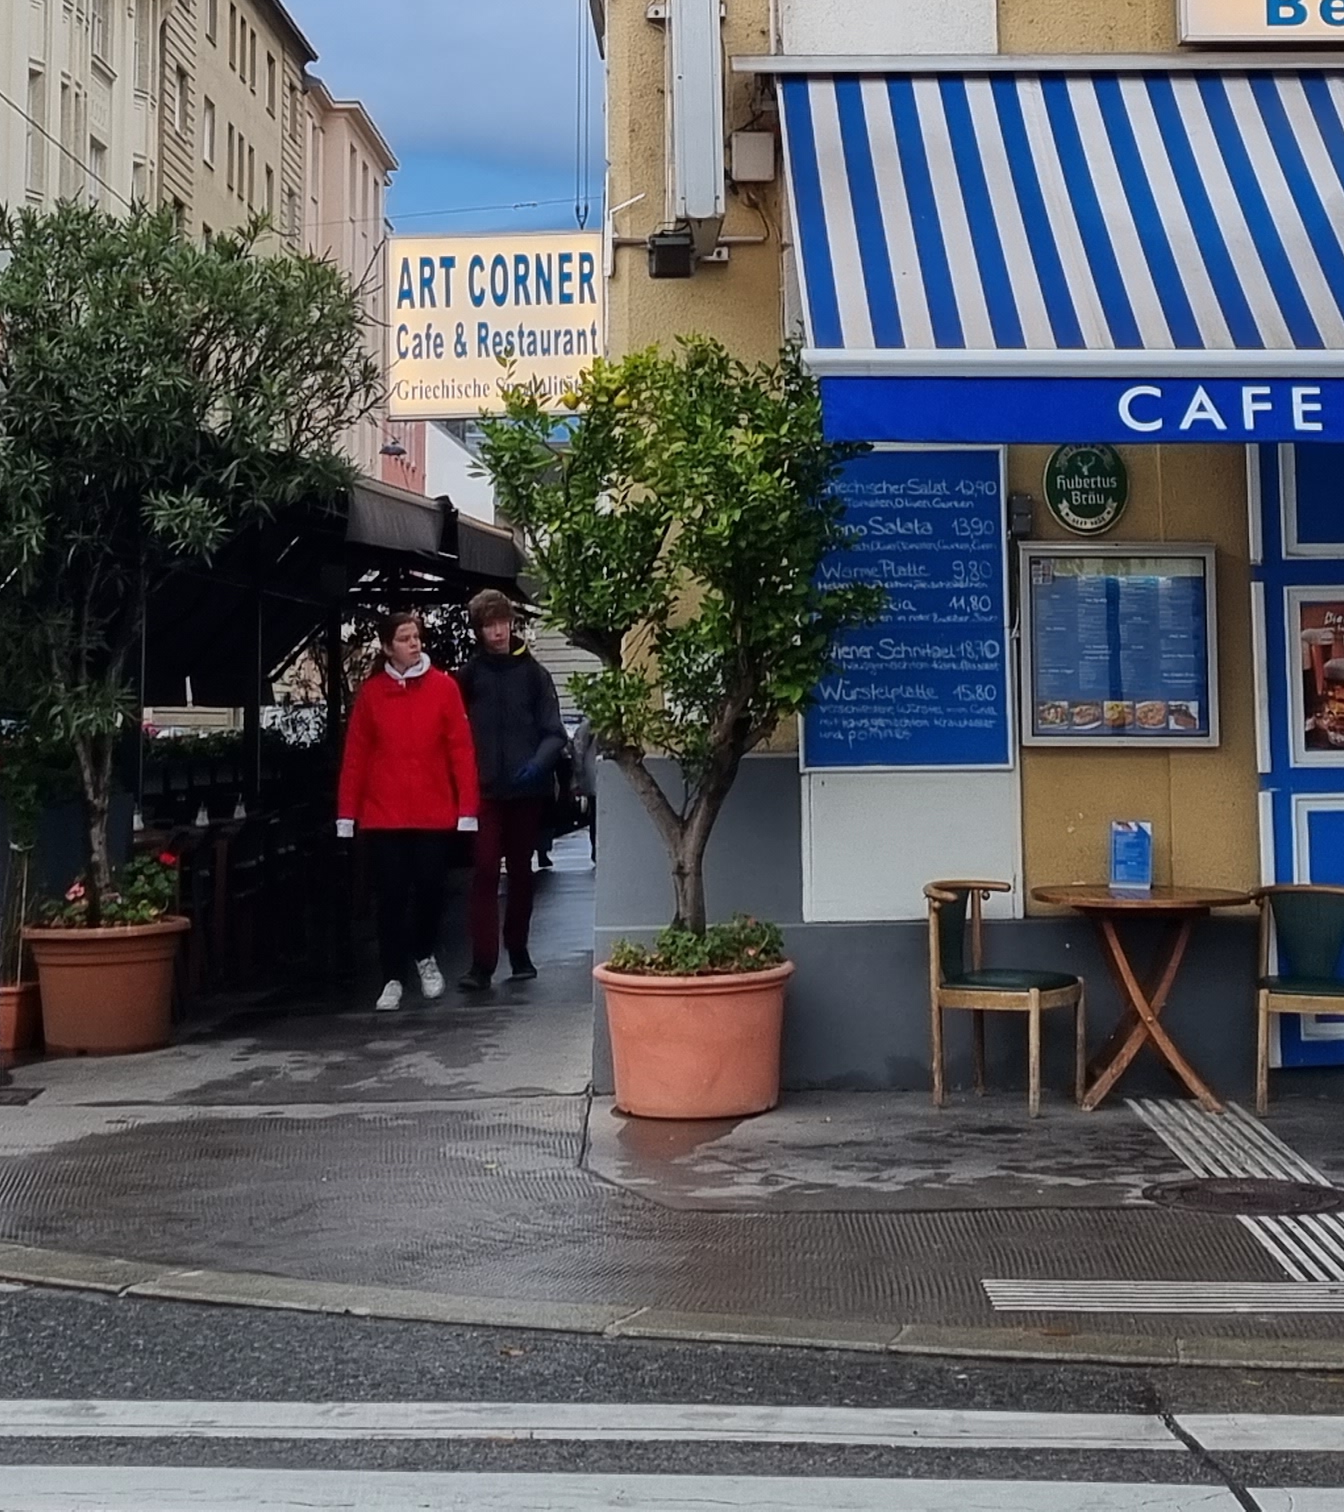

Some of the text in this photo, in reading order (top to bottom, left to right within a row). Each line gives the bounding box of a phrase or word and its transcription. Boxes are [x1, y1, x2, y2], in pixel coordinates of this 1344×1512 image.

[397, 252, 597, 310] ART CORNER
[396, 320, 598, 360] Cafe & Restaurant
[397, 377, 490, 400] Griechische
[1118, 384, 1324, 432] CAFE
[907, 478, 951, 496] Salat
[1056, 474, 1117, 491] Hubertus
[1071, 491, 1105, 505] Bräu
[952, 560, 993, 584] 9,80
